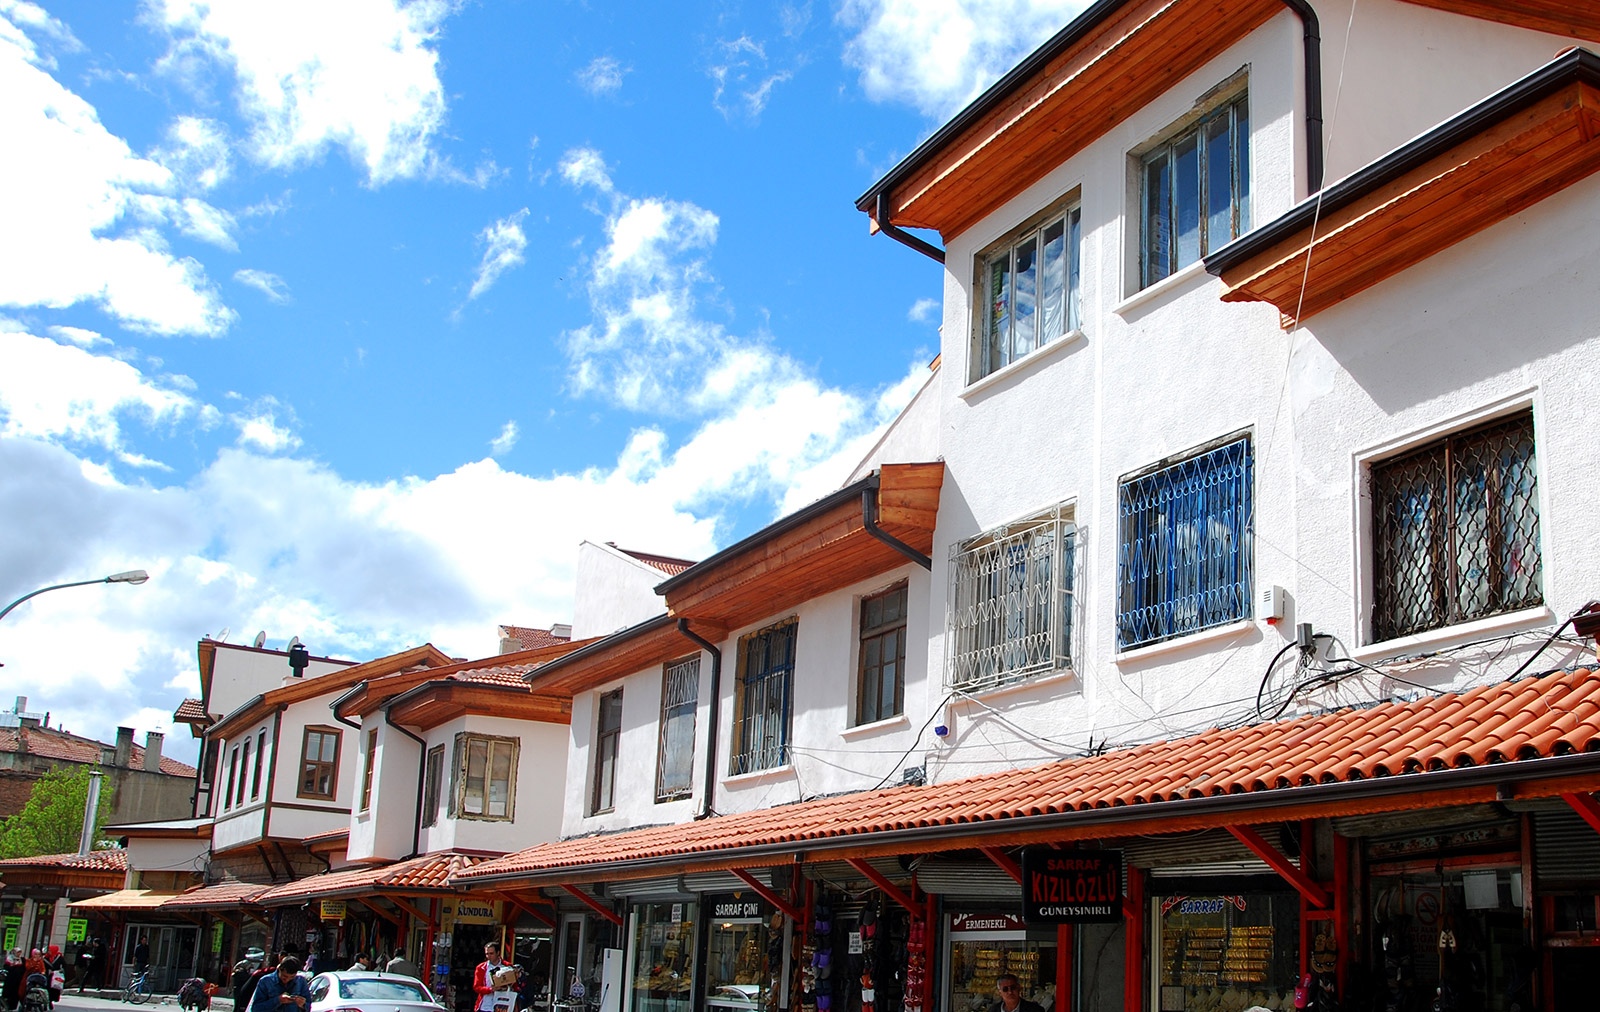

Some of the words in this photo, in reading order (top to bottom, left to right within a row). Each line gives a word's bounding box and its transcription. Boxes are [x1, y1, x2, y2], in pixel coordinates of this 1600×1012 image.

[1047, 858, 1102, 871] SARRAF
[1032, 864, 1117, 903] KIZILÖZLÜ
[457, 907, 494, 918] KUNDURA
[715, 903, 742, 916] SARRAF
[1039, 905, 1111, 916] GÜNEYSINIRLI
[1180, 899, 1225, 914] SARRAF
